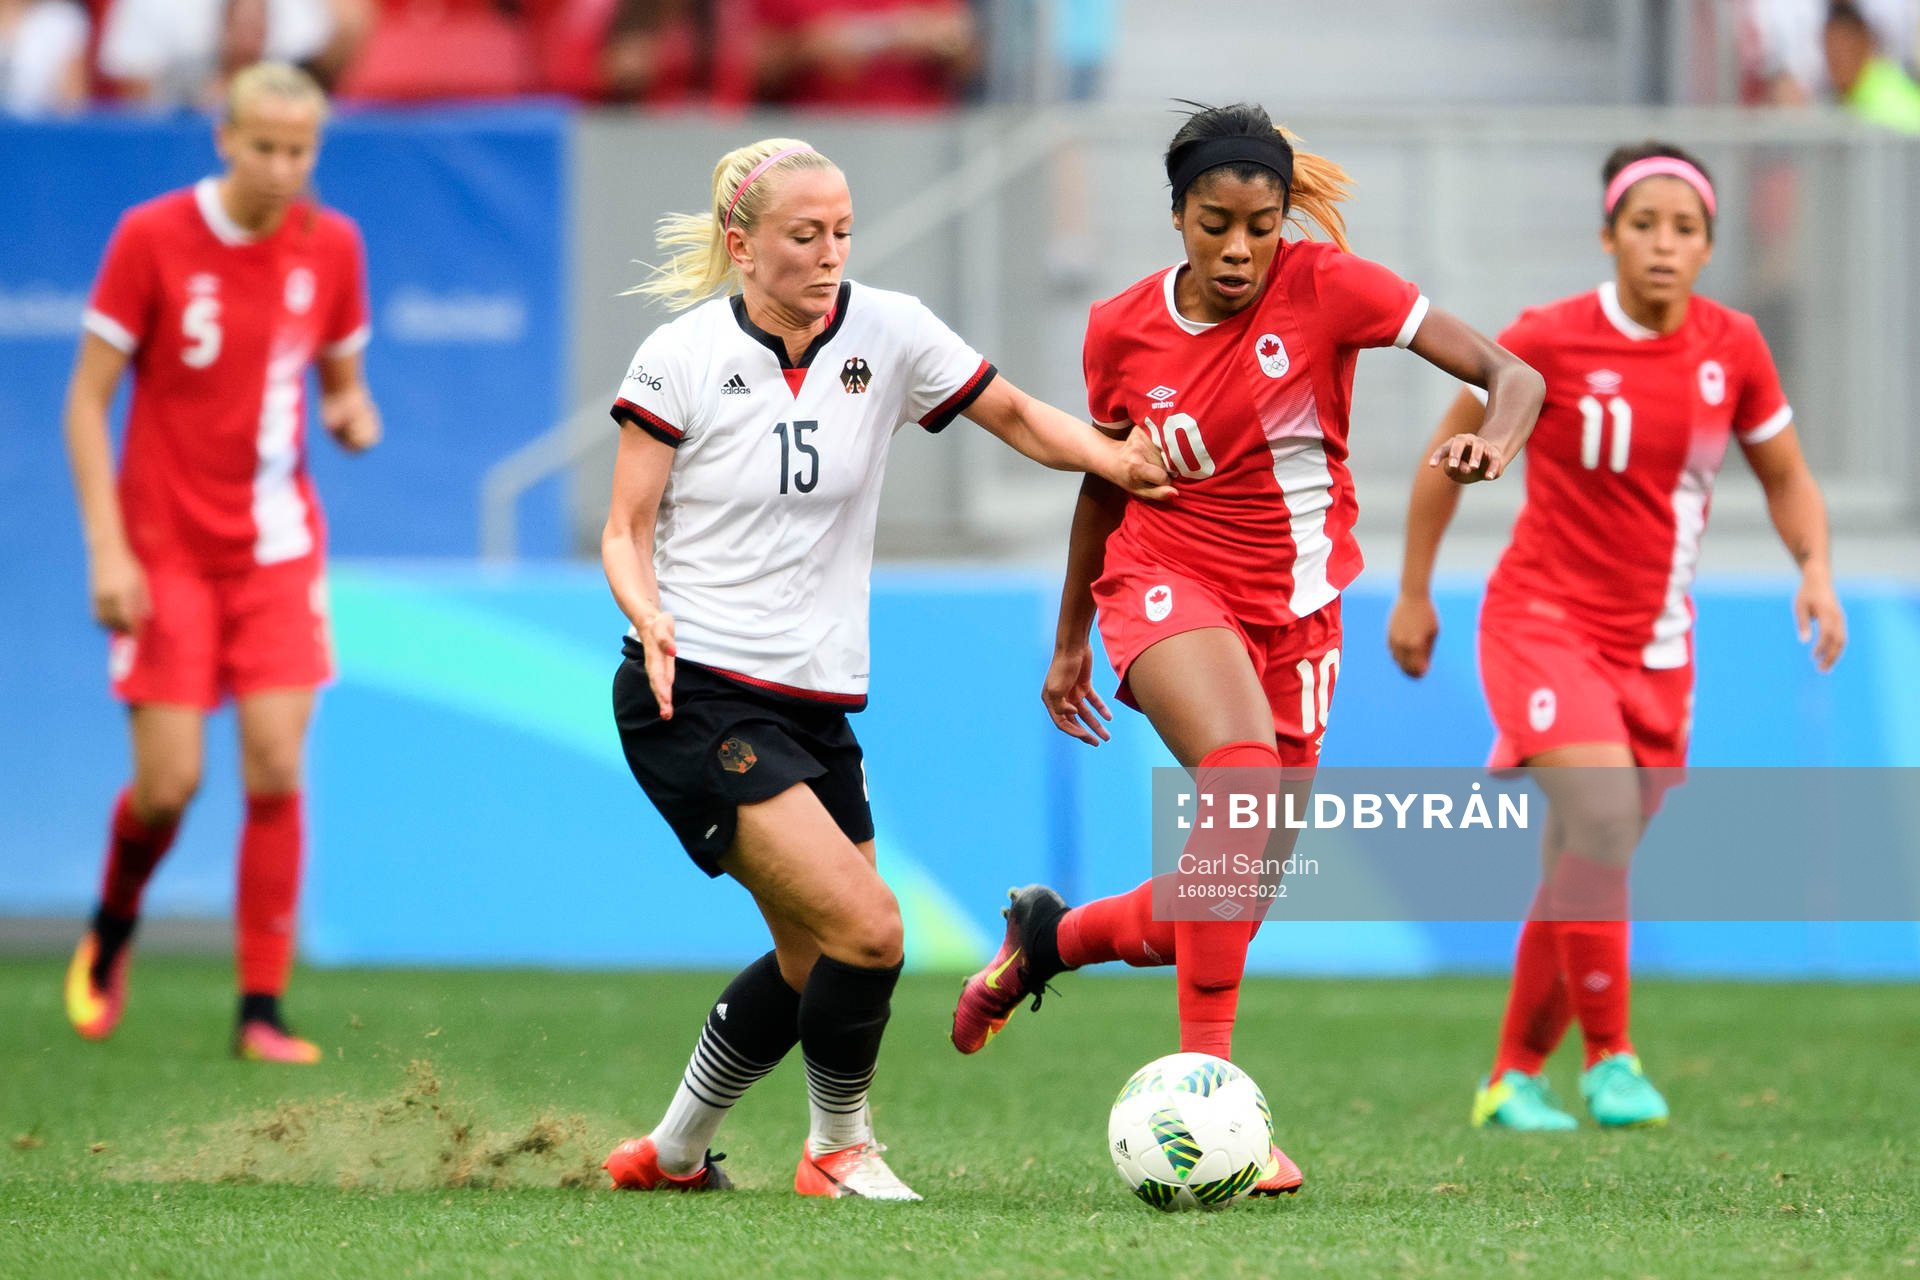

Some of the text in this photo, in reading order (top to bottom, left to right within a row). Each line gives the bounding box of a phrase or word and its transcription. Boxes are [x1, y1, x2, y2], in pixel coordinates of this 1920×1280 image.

[181, 296, 222, 368] 5
[720, 387, 751, 395] adidas
[1151, 401, 1174, 410] umbro
[772, 420, 819, 495] 15
[1578, 395, 1632, 472] 11
[1296, 648, 1341, 734] 10
